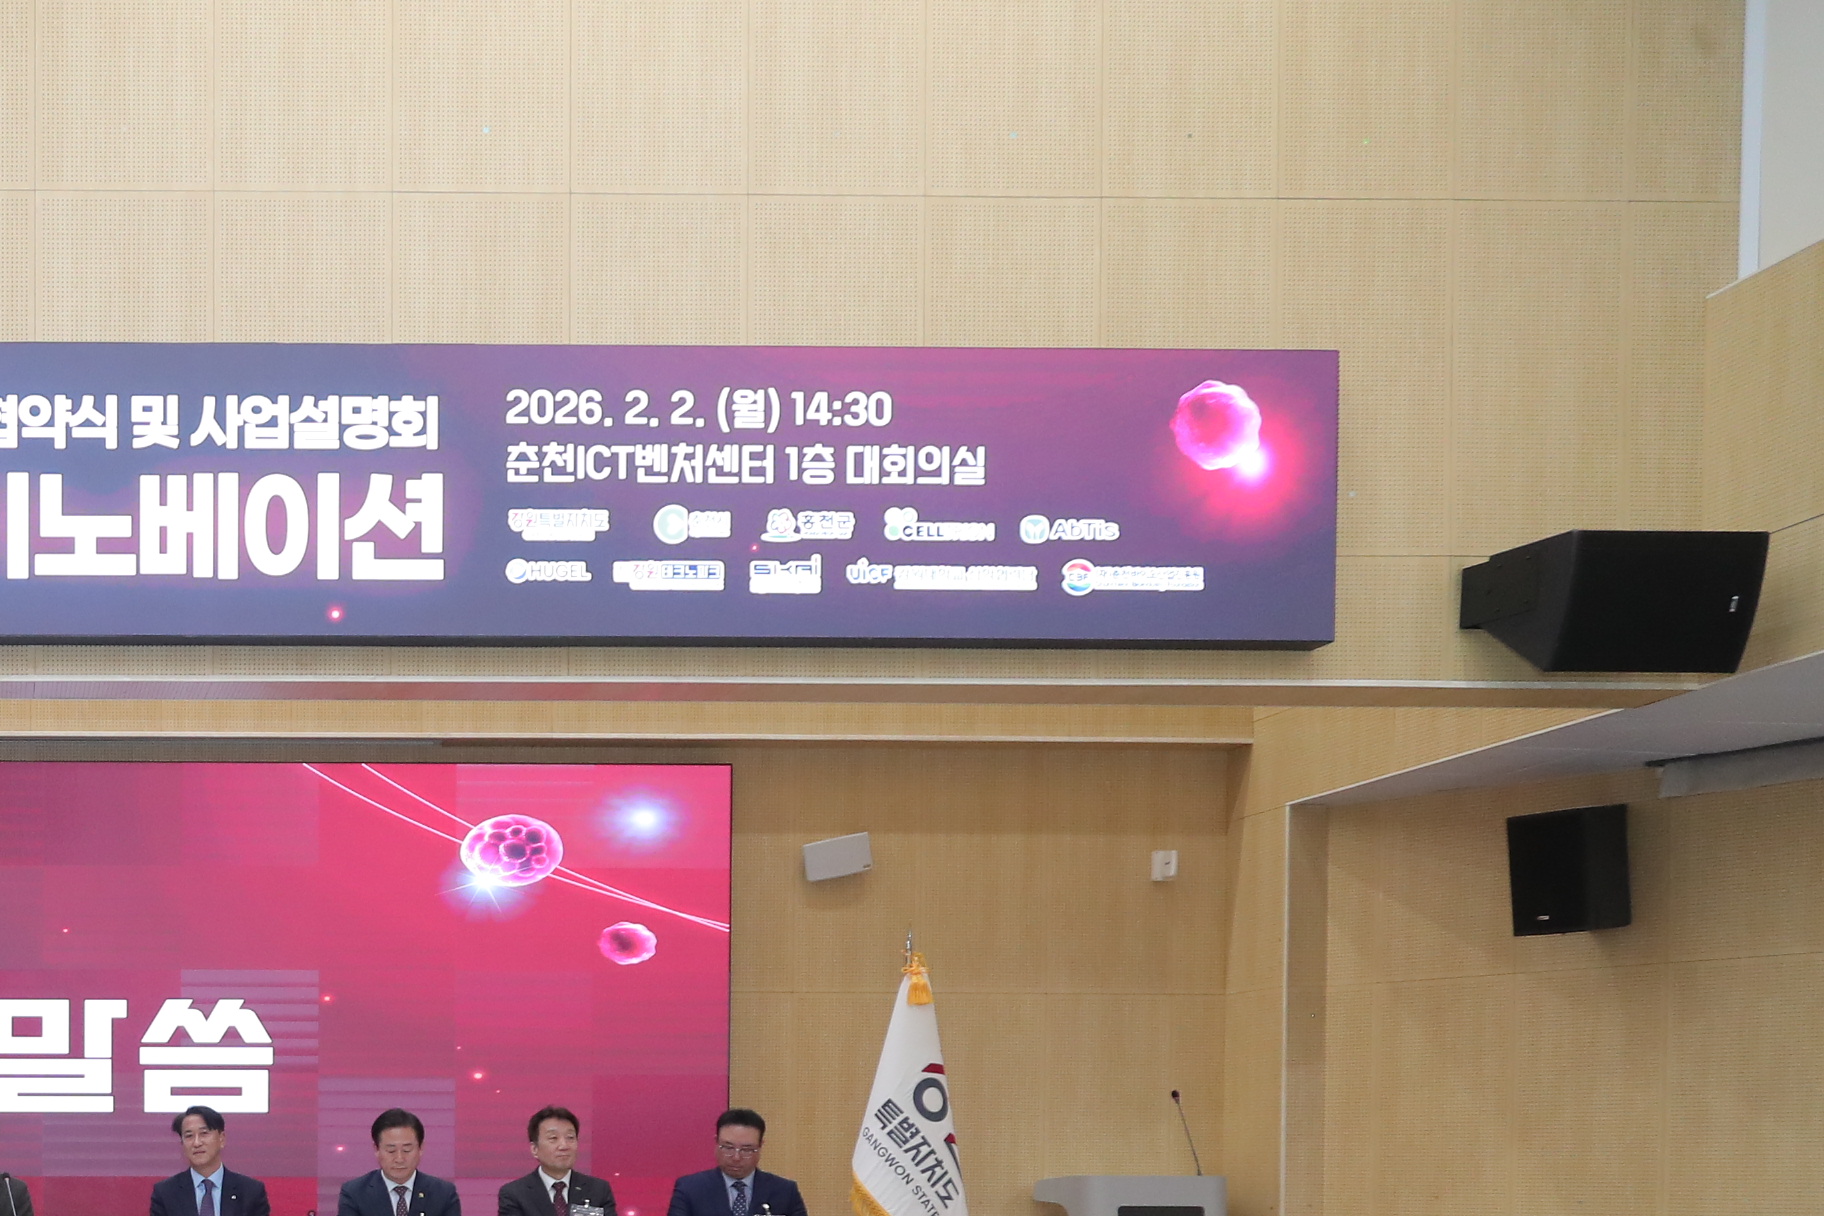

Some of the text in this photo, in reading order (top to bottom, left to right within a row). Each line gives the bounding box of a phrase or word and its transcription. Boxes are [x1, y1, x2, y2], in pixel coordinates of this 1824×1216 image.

[131, 395, 180, 449] 및
[190, 395, 439, 450] 사업설명회
[506, 387, 892, 433] 2026. 2. 2. (월) 14:30
[506, 441, 985, 485] 춘천ICT벤처센터 1층 대회의실
[530, 564, 589, 578] HUGEL
[862, 1126, 915, 1186] GANGWON
[874, 1098, 960, 1210] 특별자치도
